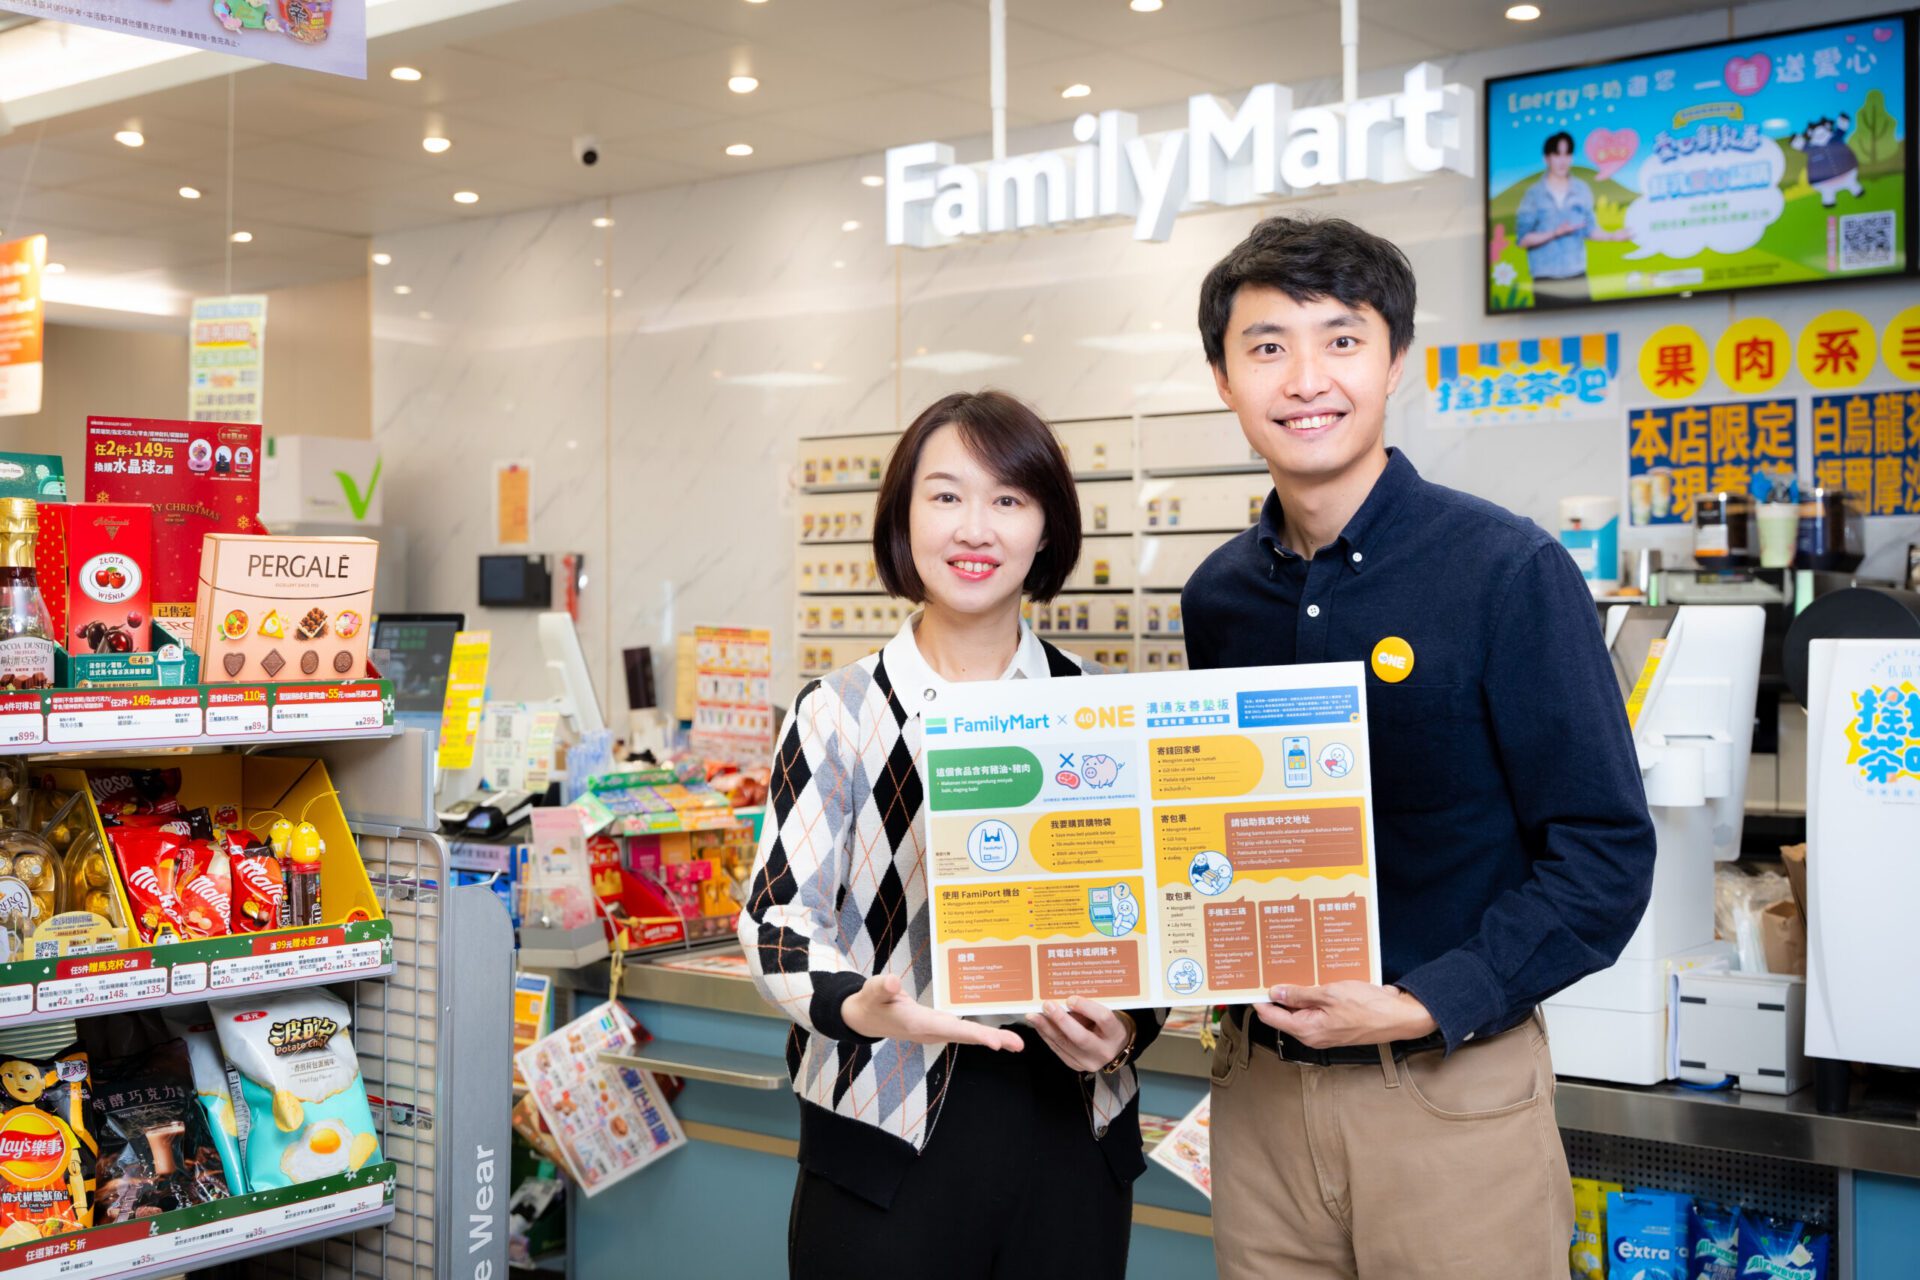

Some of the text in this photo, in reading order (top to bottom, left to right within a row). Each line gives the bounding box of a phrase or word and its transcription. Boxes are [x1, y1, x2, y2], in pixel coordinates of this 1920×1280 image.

[885, 66, 1452, 242] FamilyMart
[1629, 402, 1795, 465] 本店限定
[95, 440, 174, 459] 任2件+149元
[166, 503, 220, 521] CHRISTMAS
[99, 556, 124, 565] ZŁOTA
[98, 592, 126, 601] WIŚNIA
[158, 606, 191, 618] 已售完
[1146, 697, 1230, 715] 溝通友善墊板
[954, 714, 1050, 733] FamilyMart
[1156, 745, 1201, 756] 寄錢回家鄉
[1050, 817, 1112, 829] 我要購買購物袋
[1160, 814, 1187, 824] 寄包裹
[1230, 815, 1311, 828] 請協助我寫中文地址
[943, 888, 1020, 900] 使用 FamiPort 機台
[1165, 892, 1192, 902] 取包裹
[275, 1040, 306, 1056] Potato
[31, 1140, 62, 1155] 樂事
[468, 1144, 495, 1254] Wear
[26, 1239, 87, 1262] 任選第2件5折
[1618, 1240, 1670, 1260] extra
